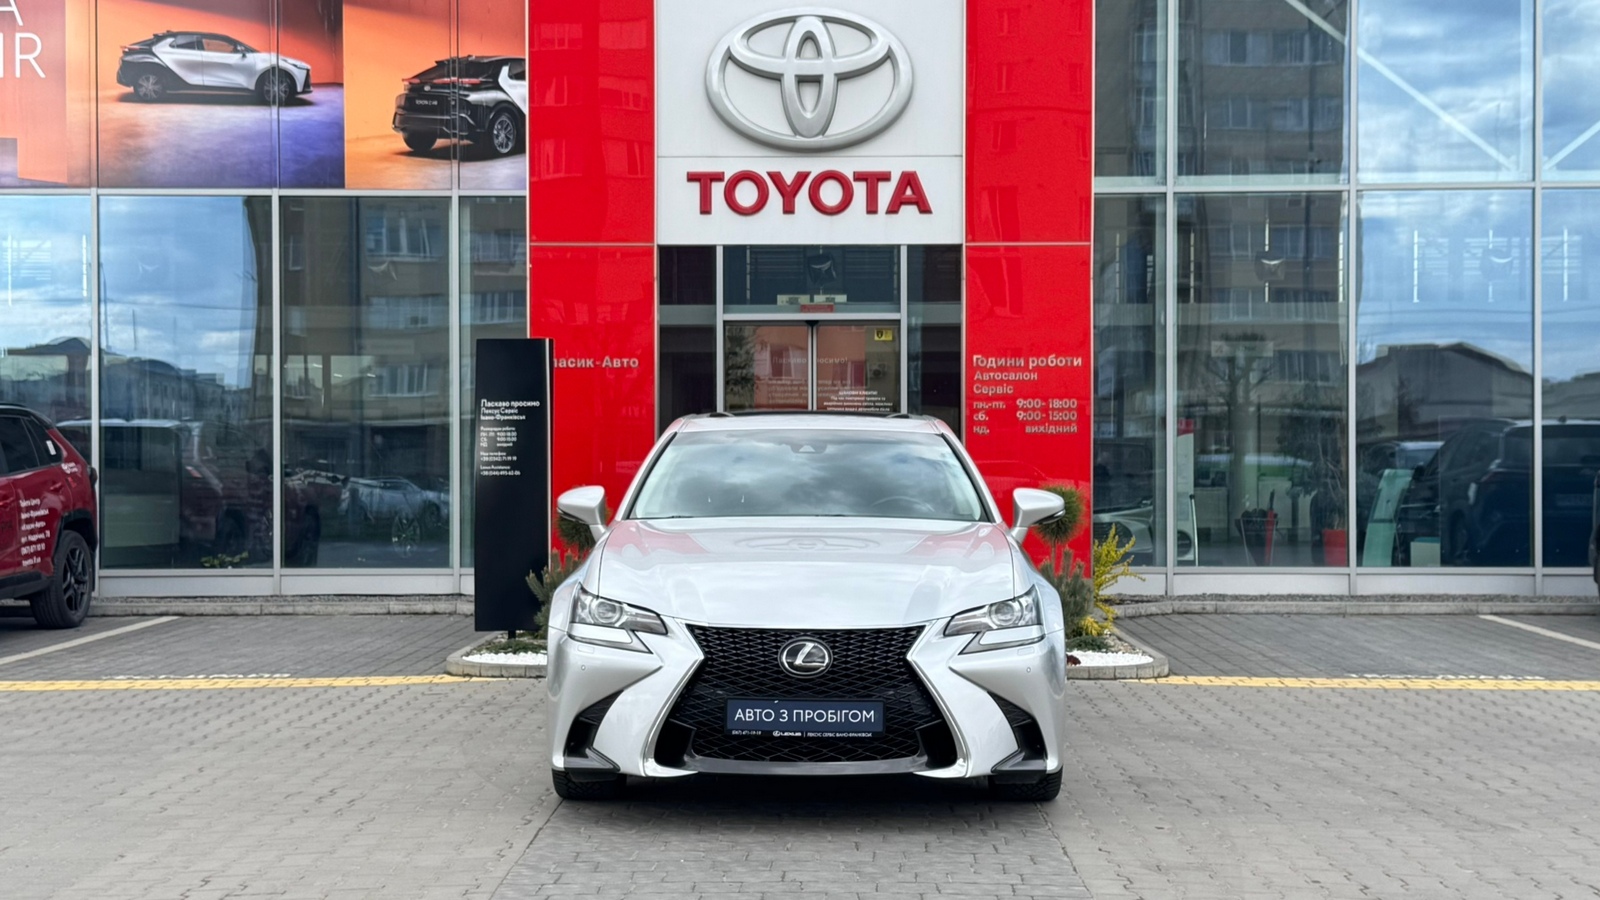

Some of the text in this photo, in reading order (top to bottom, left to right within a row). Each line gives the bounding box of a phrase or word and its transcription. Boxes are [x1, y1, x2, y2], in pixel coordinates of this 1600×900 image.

[687, 170, 933, 216] TOYOTA
[973, 353, 1082, 370] Години роботи
[973, 371, 1038, 381] Автосалон
[973, 383, 1014, 396] Сервіс
[481, 399, 540, 408] Ласкаво просимо
[1025, 423, 1078, 434] вихідний
[734, 708, 775, 722] АВТО
[793, 709, 875, 723] ПРОБІГОМ
